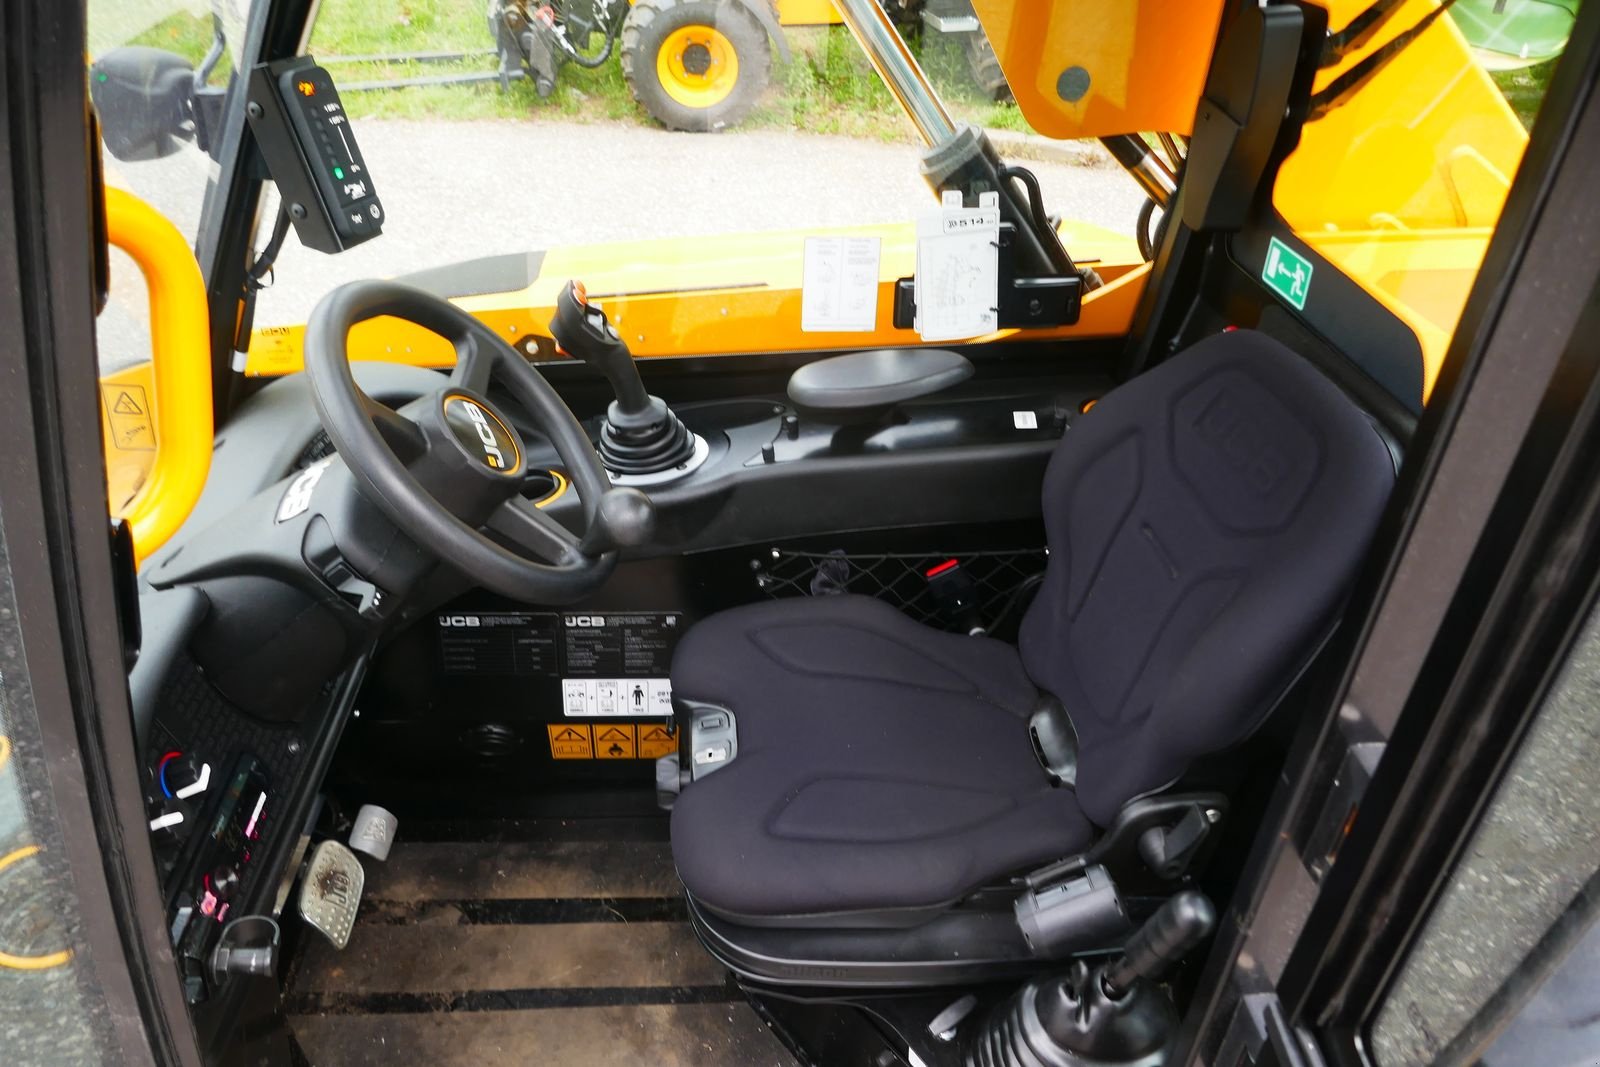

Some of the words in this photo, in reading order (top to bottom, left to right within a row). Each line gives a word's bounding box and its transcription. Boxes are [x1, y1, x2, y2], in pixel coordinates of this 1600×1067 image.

[462, 401, 505, 469] JCB
[439, 616, 480, 627] JCB
[565, 616, 606, 627] JCB
